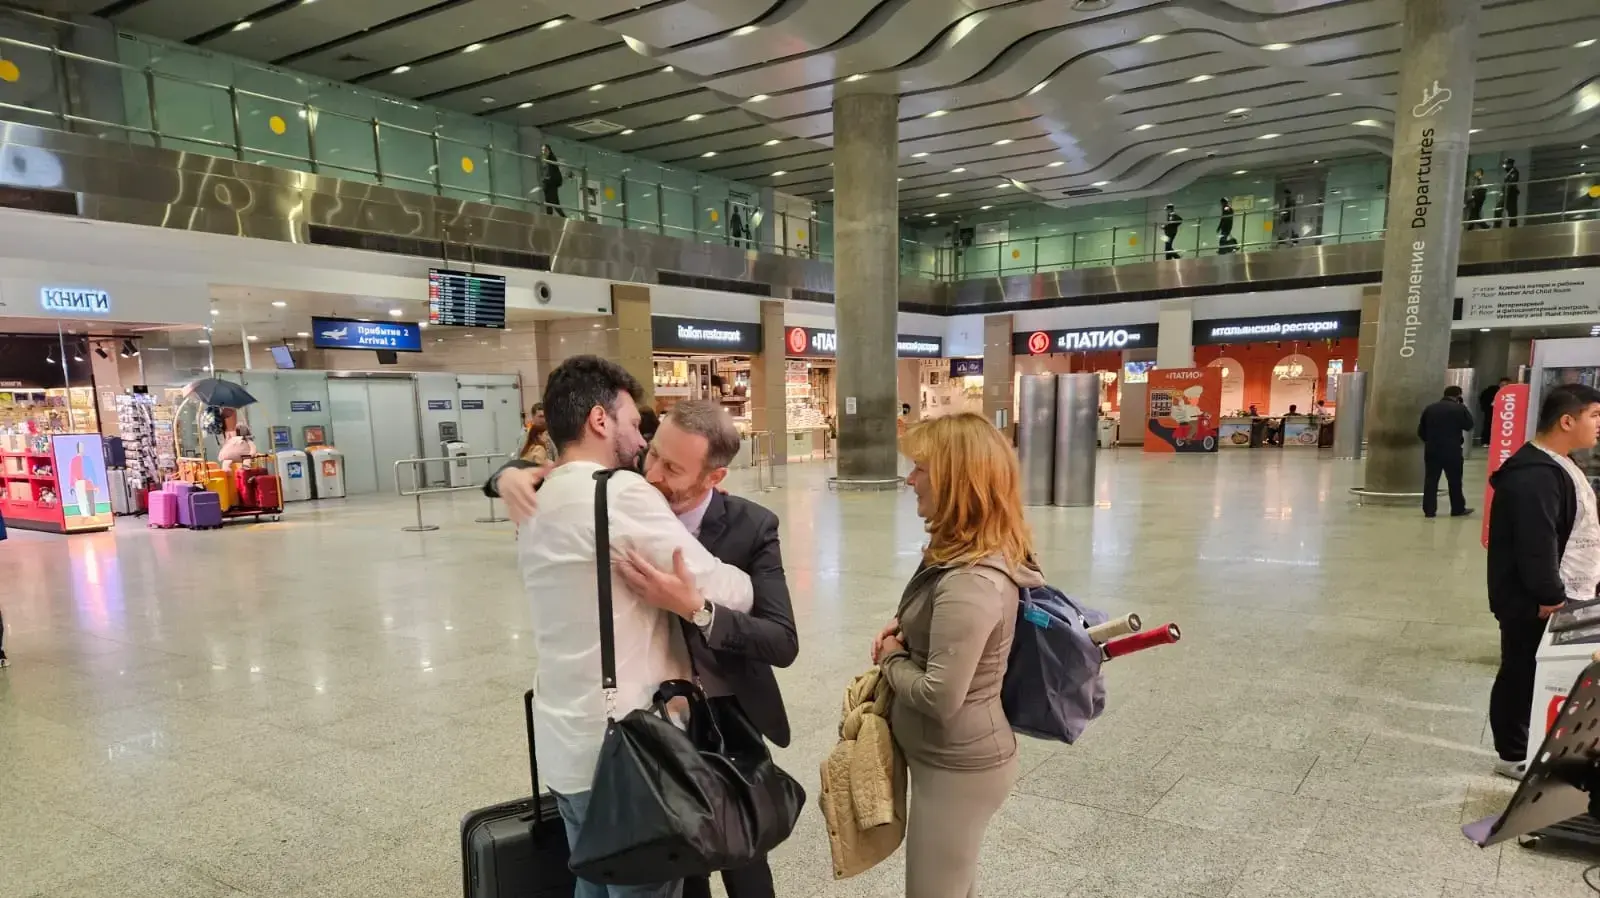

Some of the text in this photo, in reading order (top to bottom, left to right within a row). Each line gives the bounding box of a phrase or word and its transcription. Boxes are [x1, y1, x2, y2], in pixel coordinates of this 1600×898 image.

[1411, 127, 1435, 229] Departures
[43, 289, 109, 310] КНИГИ
[1400, 240, 1426, 358] Отправление
[357, 326, 401, 336] Прибытие
[703, 329, 741, 342] restaurant
[1211, 320, 1338, 336] итальянский ресторан
[359, 336, 396, 346] Arrival 2
[817, 333, 837, 350] ПАТ
[1066, 329, 1129, 349] ПАТИО
[1170, 371, 1200, 379] ПАТИО
[1500, 393, 1517, 437] собой
